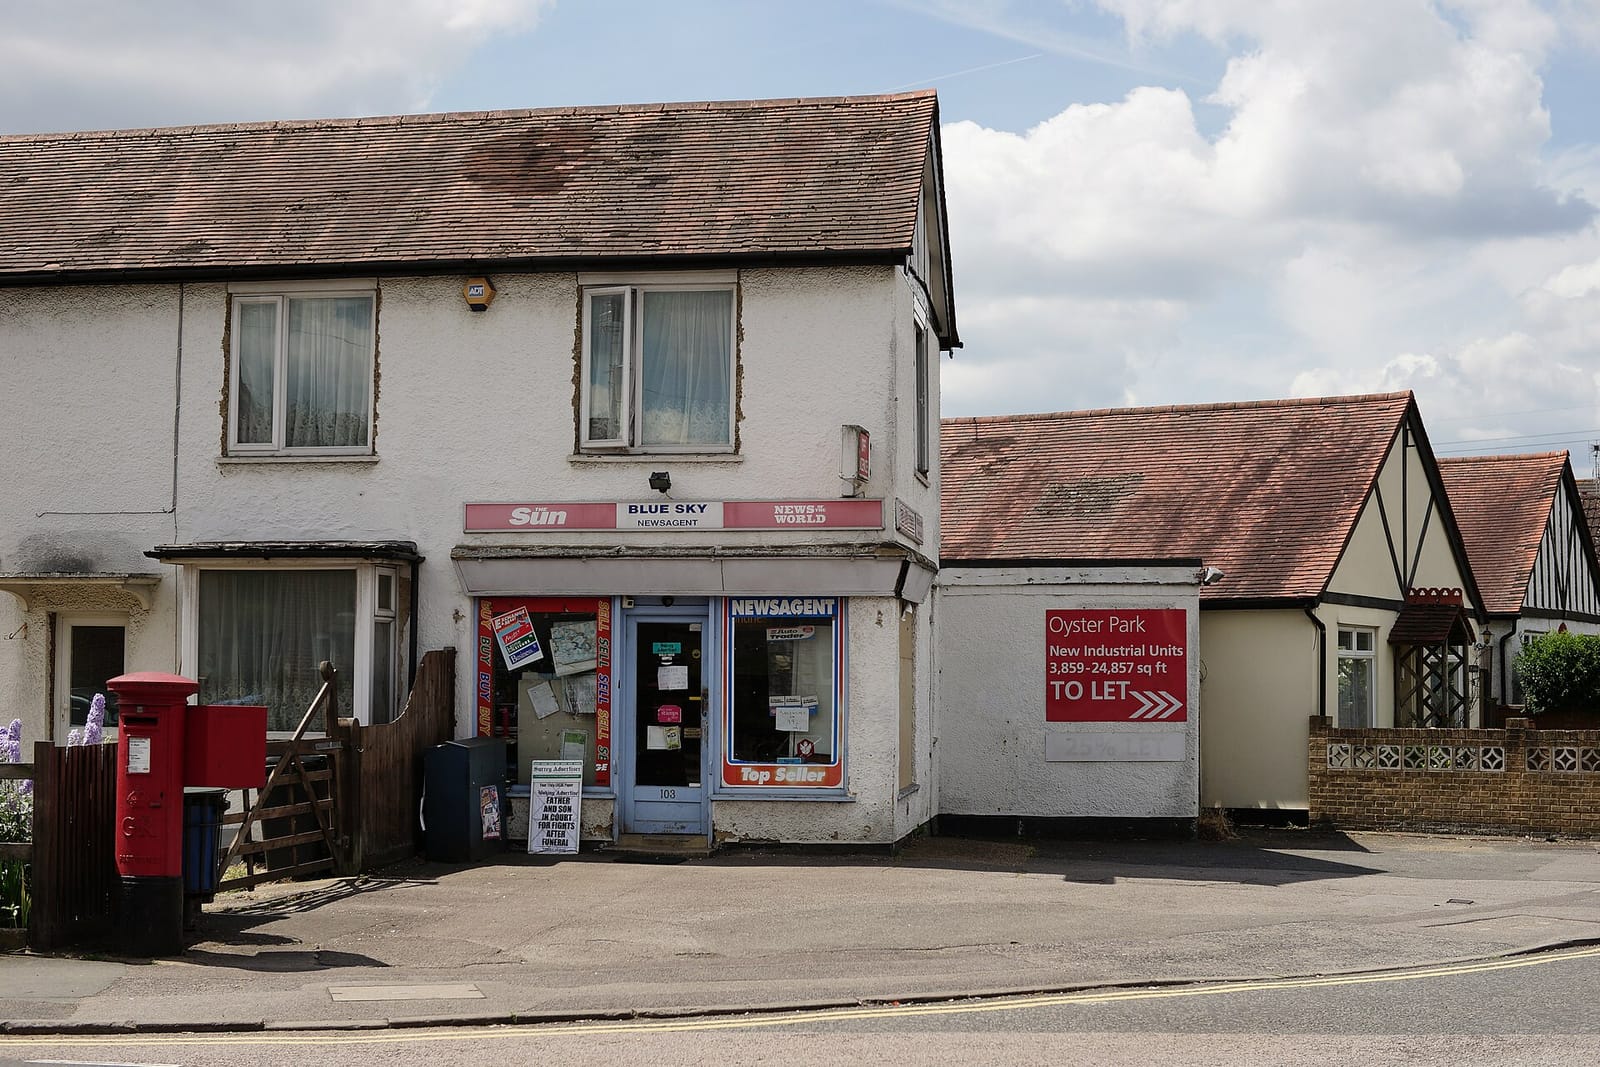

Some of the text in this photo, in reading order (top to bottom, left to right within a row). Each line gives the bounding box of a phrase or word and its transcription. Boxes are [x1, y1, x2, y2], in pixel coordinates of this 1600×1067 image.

[469, 286, 483, 295] ADT
[508, 507, 567, 525] Sun
[628, 503, 708, 514] BLUE SKY
[774, 505, 815, 514] NEWS
[637, 519, 698, 527] NEWSAGENT
[774, 514, 827, 524] WORLD
[480, 599, 492, 631] BUY
[731, 599, 835, 616] NEWSAGENT
[598, 600, 609, 632] SELL
[1049, 615, 1146, 637] Oyster Park
[480, 635, 492, 667] BUY
[598, 638, 609, 668] SELL
[1049, 644, 1184, 657] New Industrial Units
[1137, 663, 1152, 676] sq
[1155, 661, 1167, 674] ft
[479, 671, 491, 703] BUY
[598, 674, 609, 704] SELL
[1050, 681, 1131, 700] TO LET
[479, 705, 491, 737] BUY
[598, 710, 609, 740] SELL
[741, 767, 826, 785] Top Seller
[546, 796, 571, 804] FATHER
[660, 789, 676, 799] 103
[558, 805, 572, 813] SON
[541, 813, 573, 821] IN COURT
[538, 821, 575, 830] FOR FIGHTS
[546, 830, 566, 838] AFTER
[542, 838, 569, 846] FUNERAL
